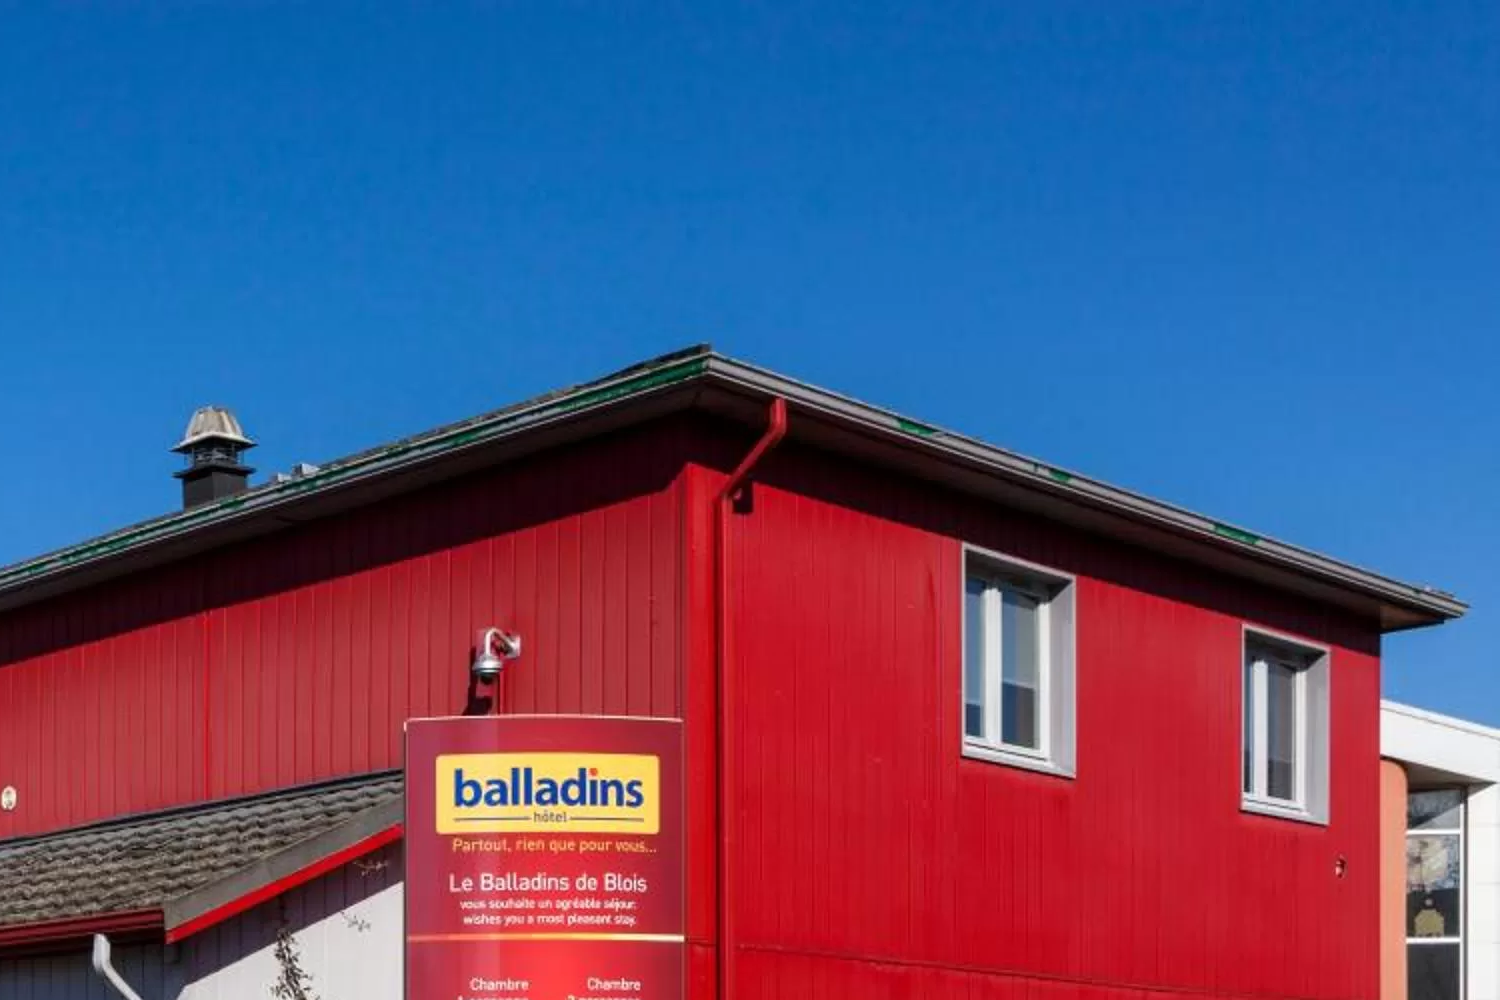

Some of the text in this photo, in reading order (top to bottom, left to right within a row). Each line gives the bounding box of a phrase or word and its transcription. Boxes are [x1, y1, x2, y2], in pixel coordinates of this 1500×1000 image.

[454, 767, 644, 808] balladins
[533, 810, 567, 823] hôtel
[452, 837, 511, 853] Partout,
[516, 837, 545, 851] rien
[550, 839, 576, 855] que
[580, 840, 612, 854] pour
[449, 872, 647, 892] Le Balladins de Blois
[469, 977, 529, 991] Chambre
[587, 977, 641, 991] Chambre
